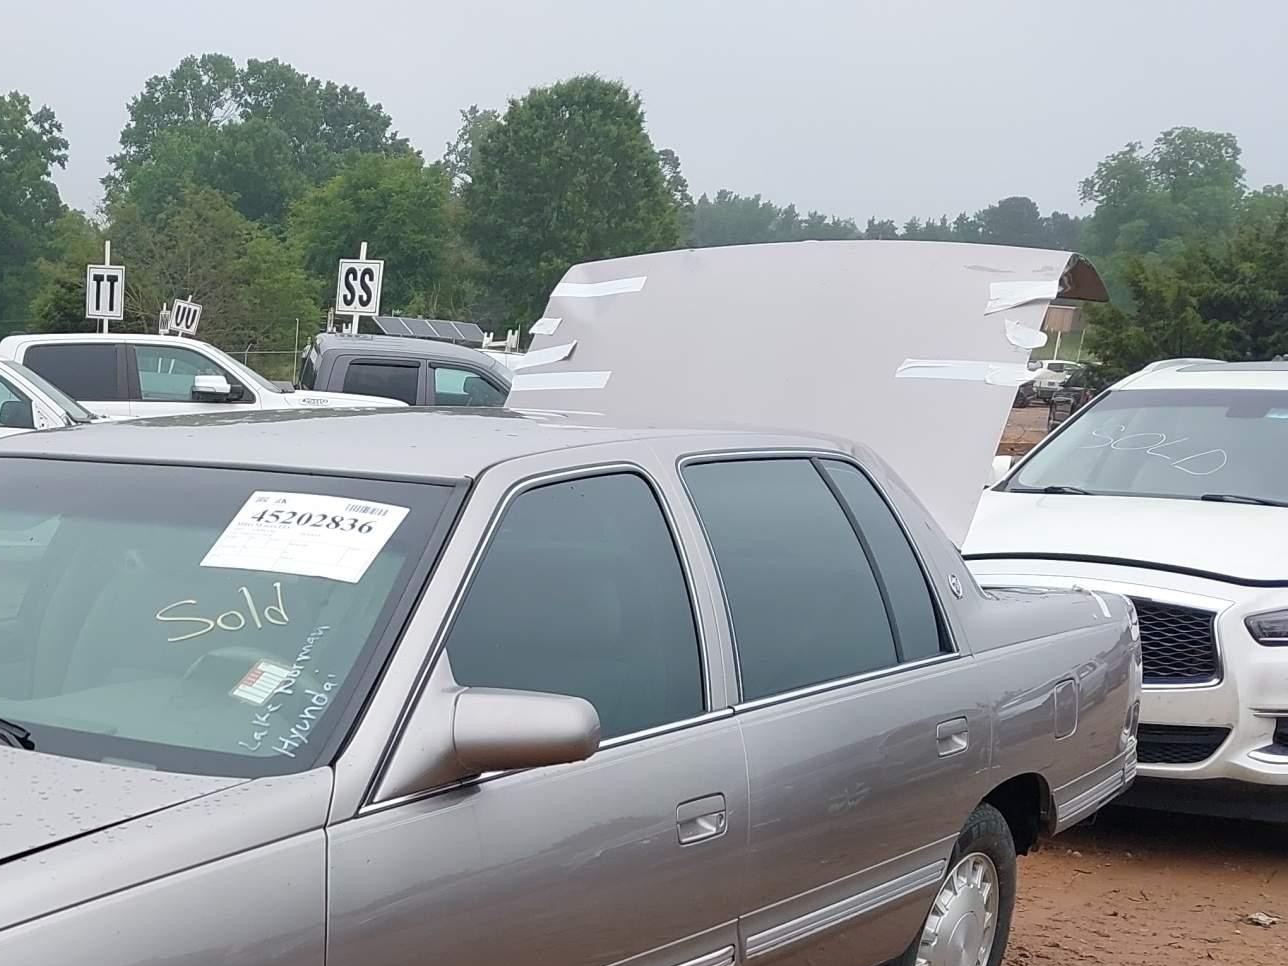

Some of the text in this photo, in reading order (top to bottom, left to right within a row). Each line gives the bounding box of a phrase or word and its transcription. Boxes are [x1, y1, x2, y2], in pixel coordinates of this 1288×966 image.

[92, 273, 119, 312] TT
[342, 266, 375, 308] SS
[1079, 429, 1228, 475] SOLD
[251, 508, 377, 535] 45202836
[156, 582, 289, 641] Sold
